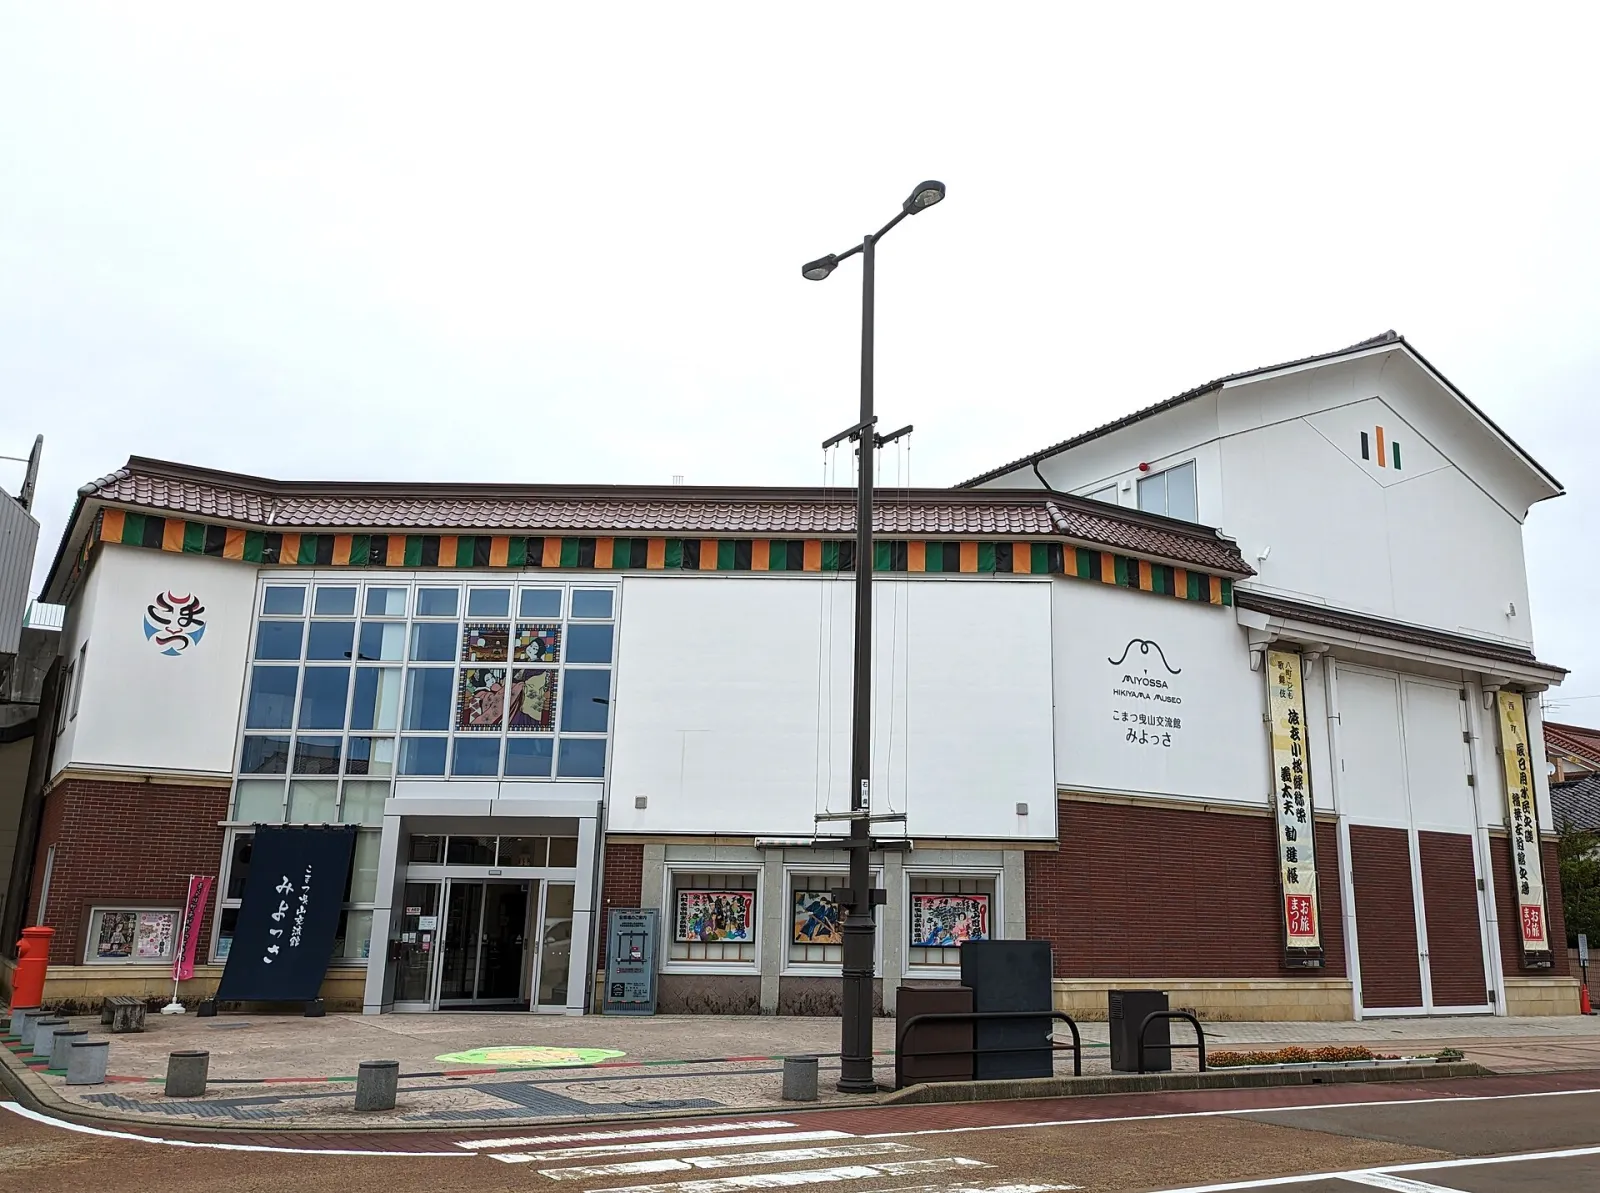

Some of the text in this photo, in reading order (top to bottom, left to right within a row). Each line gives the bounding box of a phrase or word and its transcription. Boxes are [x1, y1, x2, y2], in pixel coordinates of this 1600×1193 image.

[1121, 674, 1169, 689] MIYOSSA
[1277, 660, 1287, 699] 歌舞伎
[1113, 688, 1182, 705] HIKIYAMA MUSEO
[1112, 709, 1182, 730] こまつ曳山交流館
[1125, 727, 1172, 748] みよっさ
[1279, 765, 1300, 885] 義太夫 勧進帳
[263, 875, 294, 964] みよっさ
[1290, 897, 1300, 933] まつり
[1299, 900, 1311, 932] お旅
[1523, 907, 1531, 938] まつり
[1530, 908, 1540, 937] お旅
